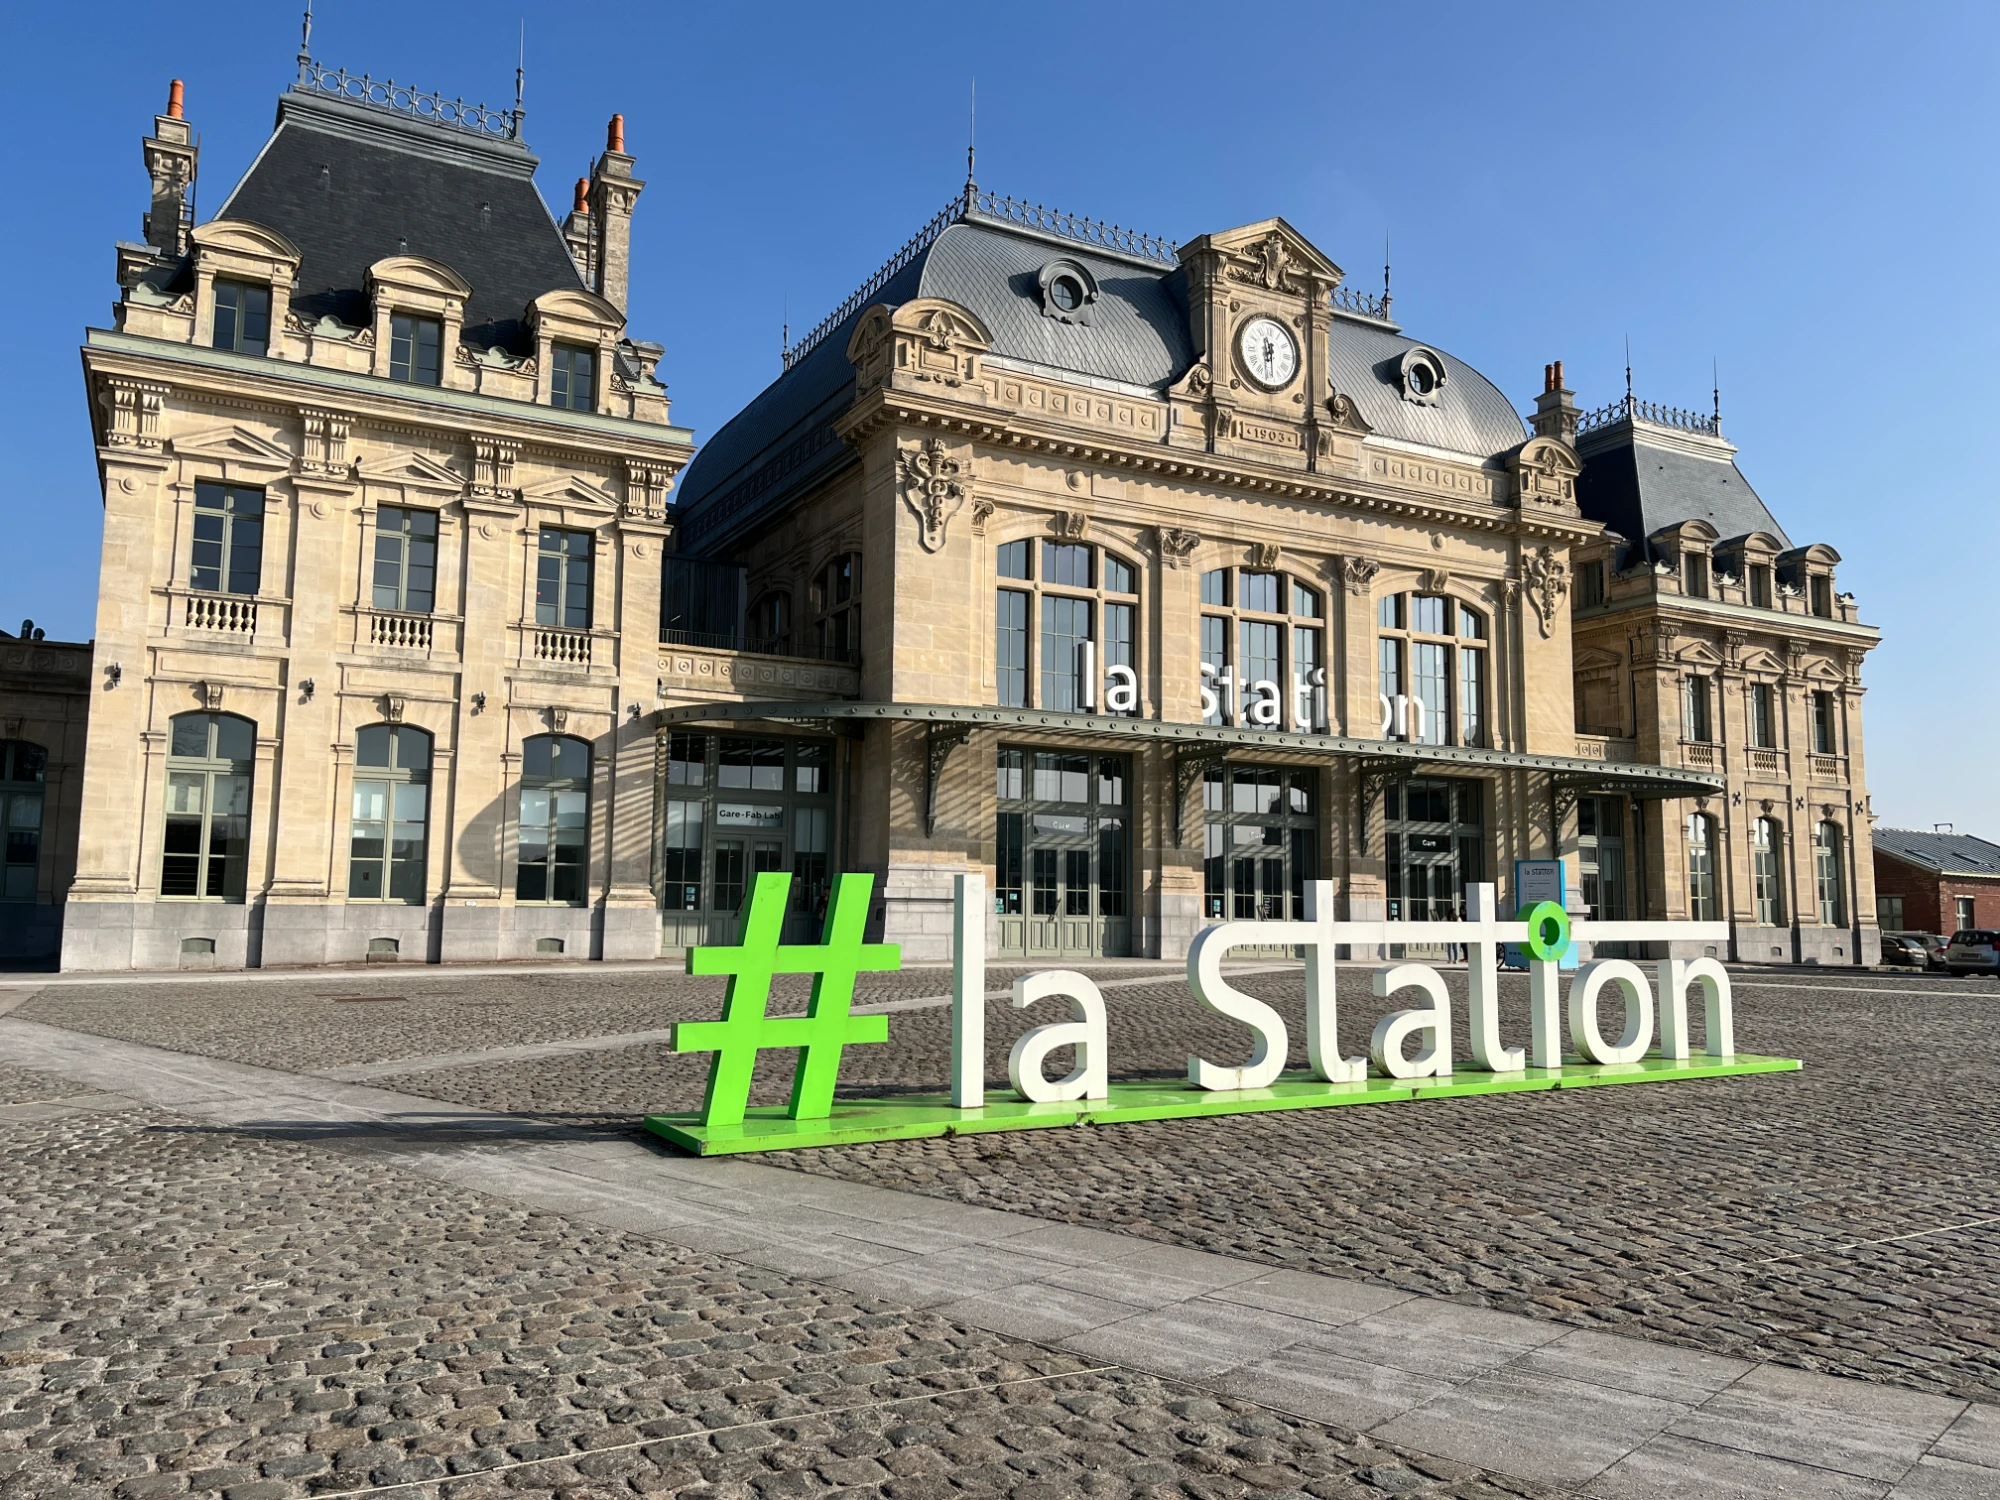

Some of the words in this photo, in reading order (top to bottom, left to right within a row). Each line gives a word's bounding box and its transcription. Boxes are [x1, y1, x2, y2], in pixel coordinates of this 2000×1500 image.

[1254, 427, 1285, 443] 1903
[1079, 641, 1137, 712] la
[764, 811, 781, 820] Lab
